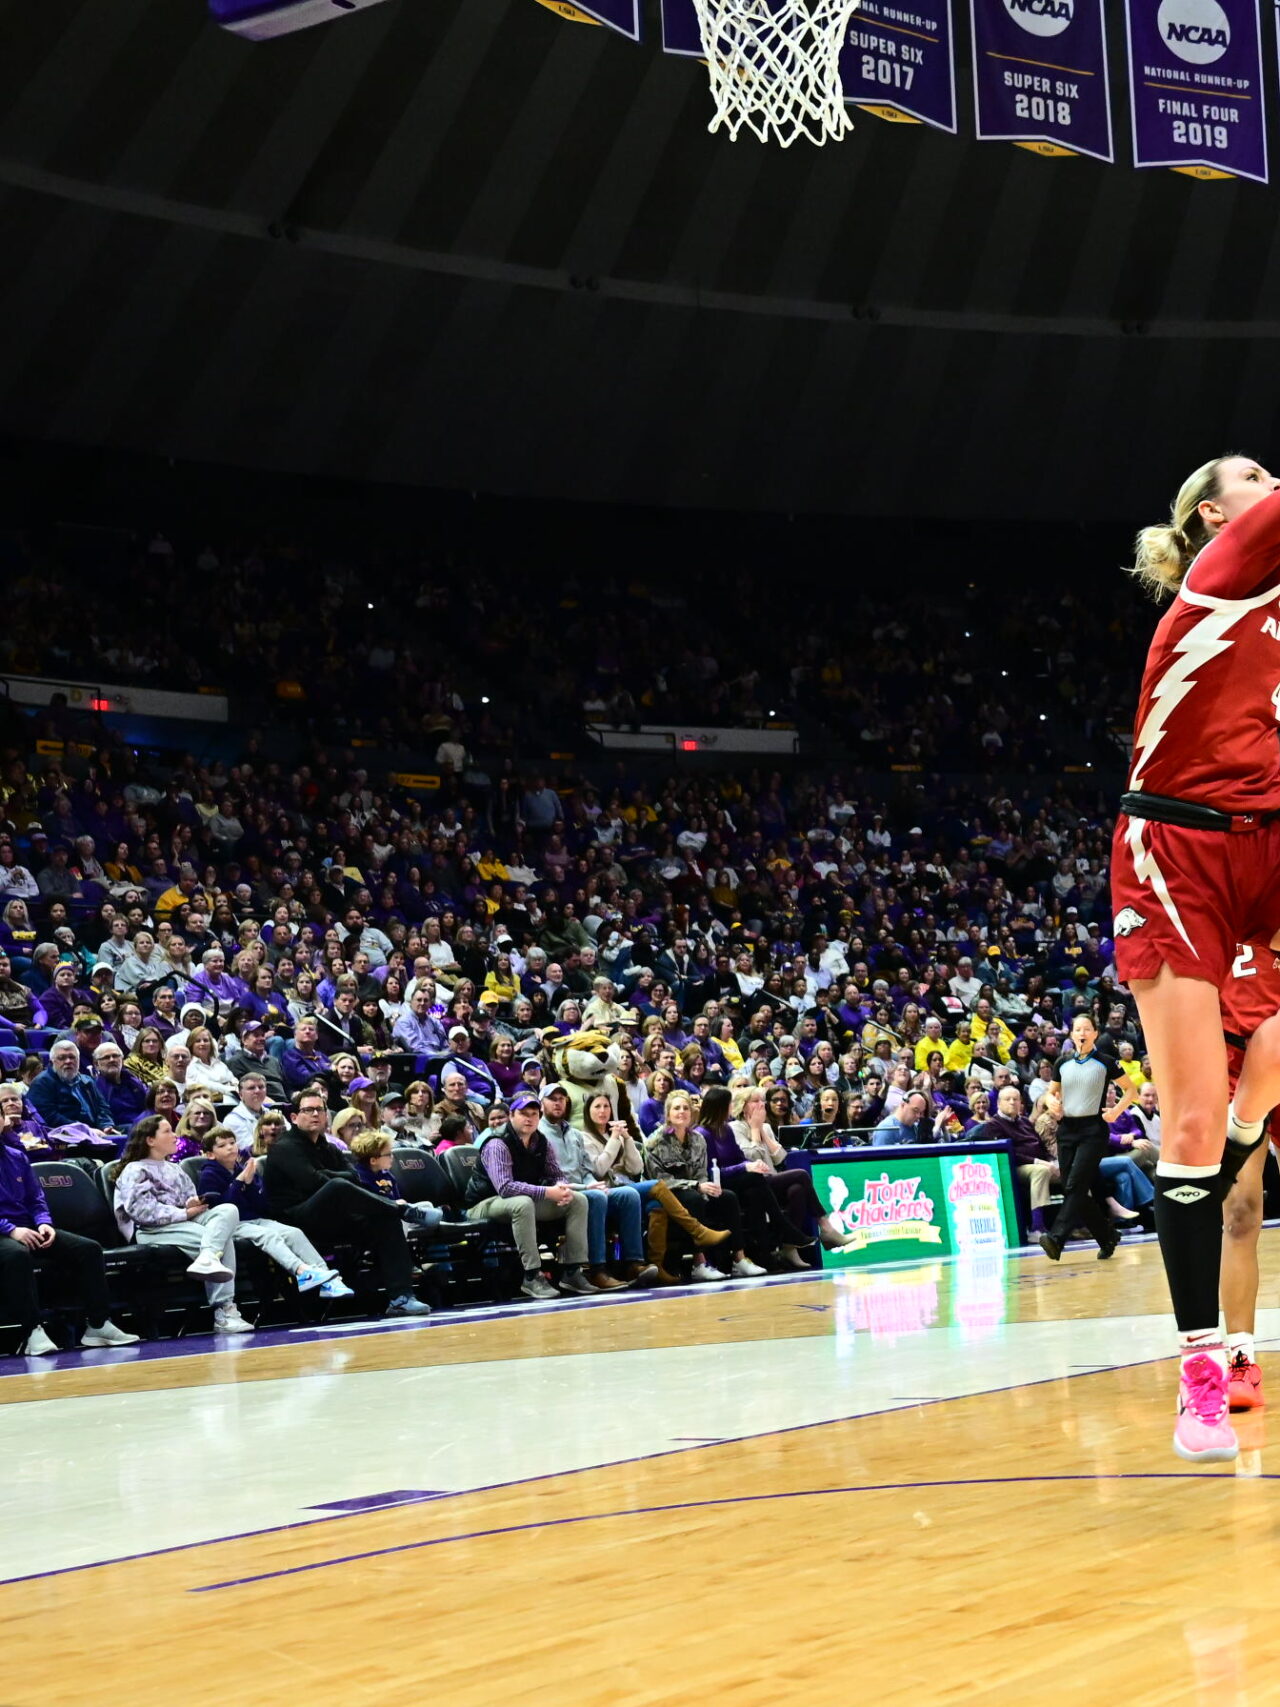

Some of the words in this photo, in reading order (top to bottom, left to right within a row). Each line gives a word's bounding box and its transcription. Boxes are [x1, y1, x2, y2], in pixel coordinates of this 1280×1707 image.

[883, 7, 937, 31] RUNNER-UP
[1010, 0, 1072, 21] NCAA
[850, 30, 896, 57] SUPER
[901, 45, 923, 66] SIX
[1167, 22, 1228, 48] NCAA
[861, 55, 914, 91] 2017
[1004, 71, 1050, 93] SUPER
[1056, 81, 1079, 99] SIX
[1144, 65, 1190, 82] NATIONAL
[1194, 73, 1249, 89] RUNNER-UP
[1015, 93, 1071, 126] 2018
[1158, 98, 1198, 118] FINAL
[1202, 104, 1239, 123] FOUR
[1172, 120, 1229, 149] 2019
[39, 1175, 73, 1188] LSU
[866, 1179, 920, 1205] Tony
